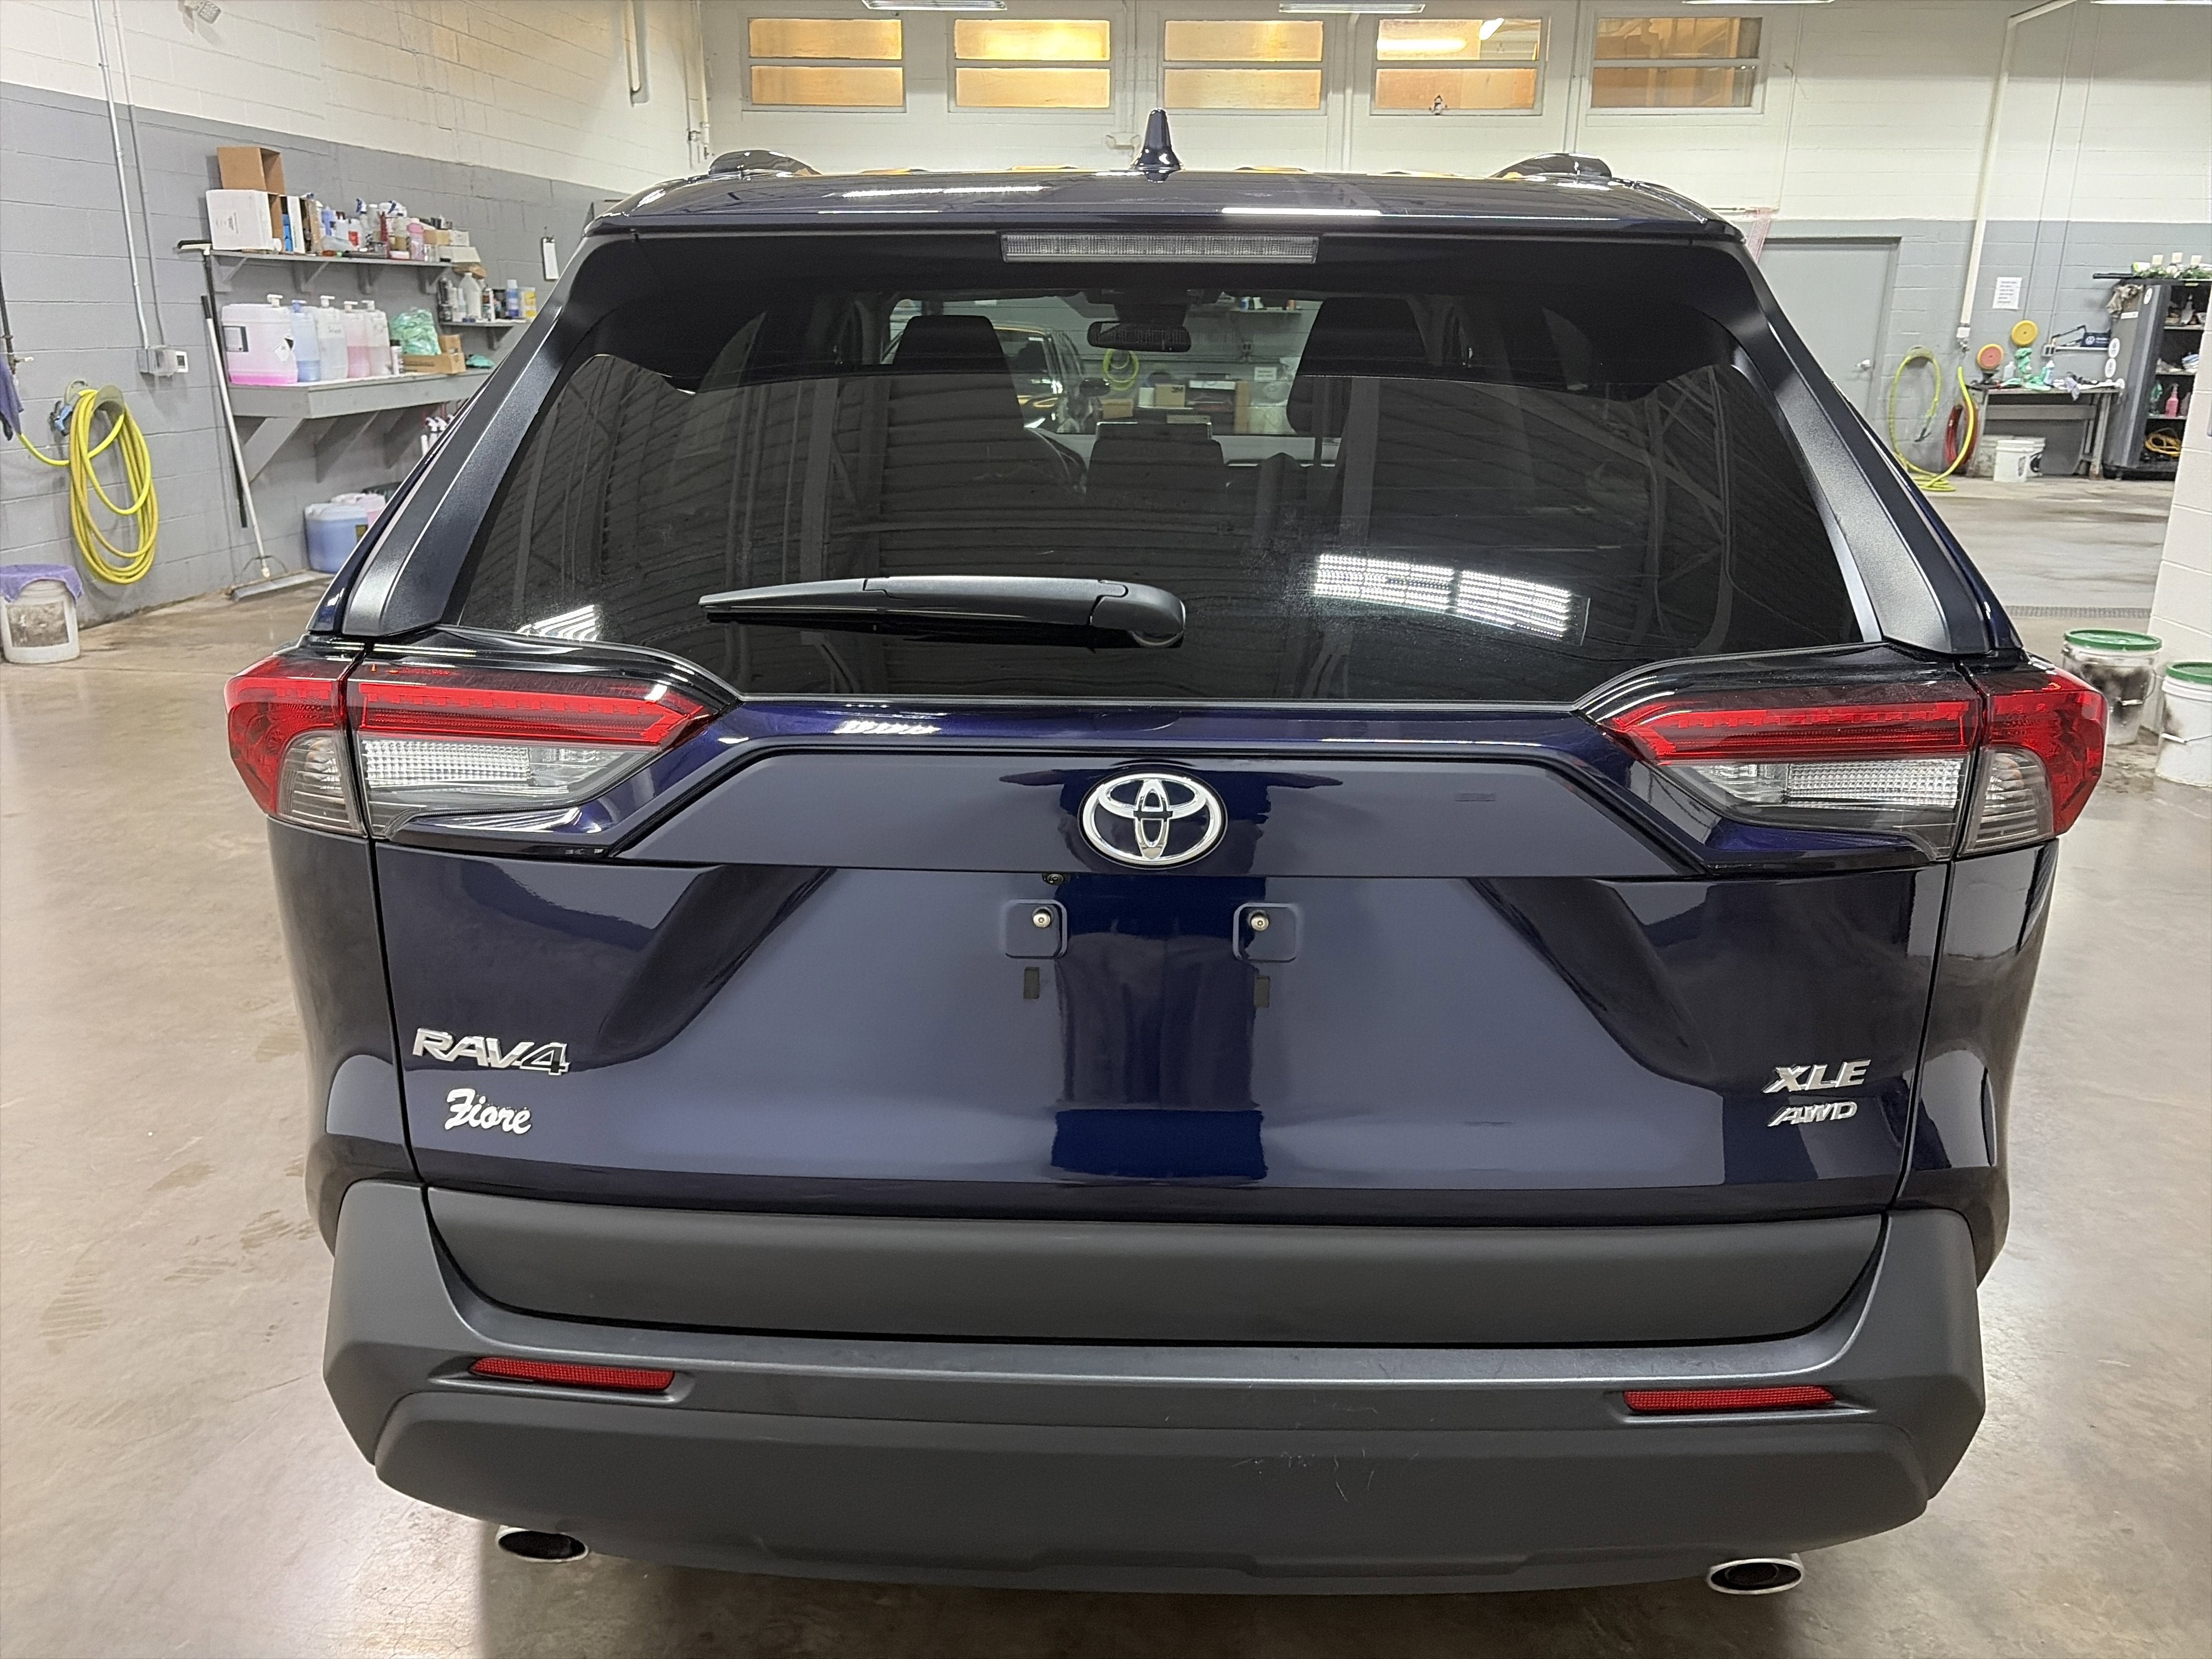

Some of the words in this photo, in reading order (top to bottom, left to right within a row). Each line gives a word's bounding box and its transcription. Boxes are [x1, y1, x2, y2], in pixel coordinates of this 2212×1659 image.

[413, 1028, 571, 1075] RAV4
[1762, 1059, 1871, 1093] XLE
[444, 1088, 532, 1134] Fiore
[1767, 1101, 1858, 1127] AWD
